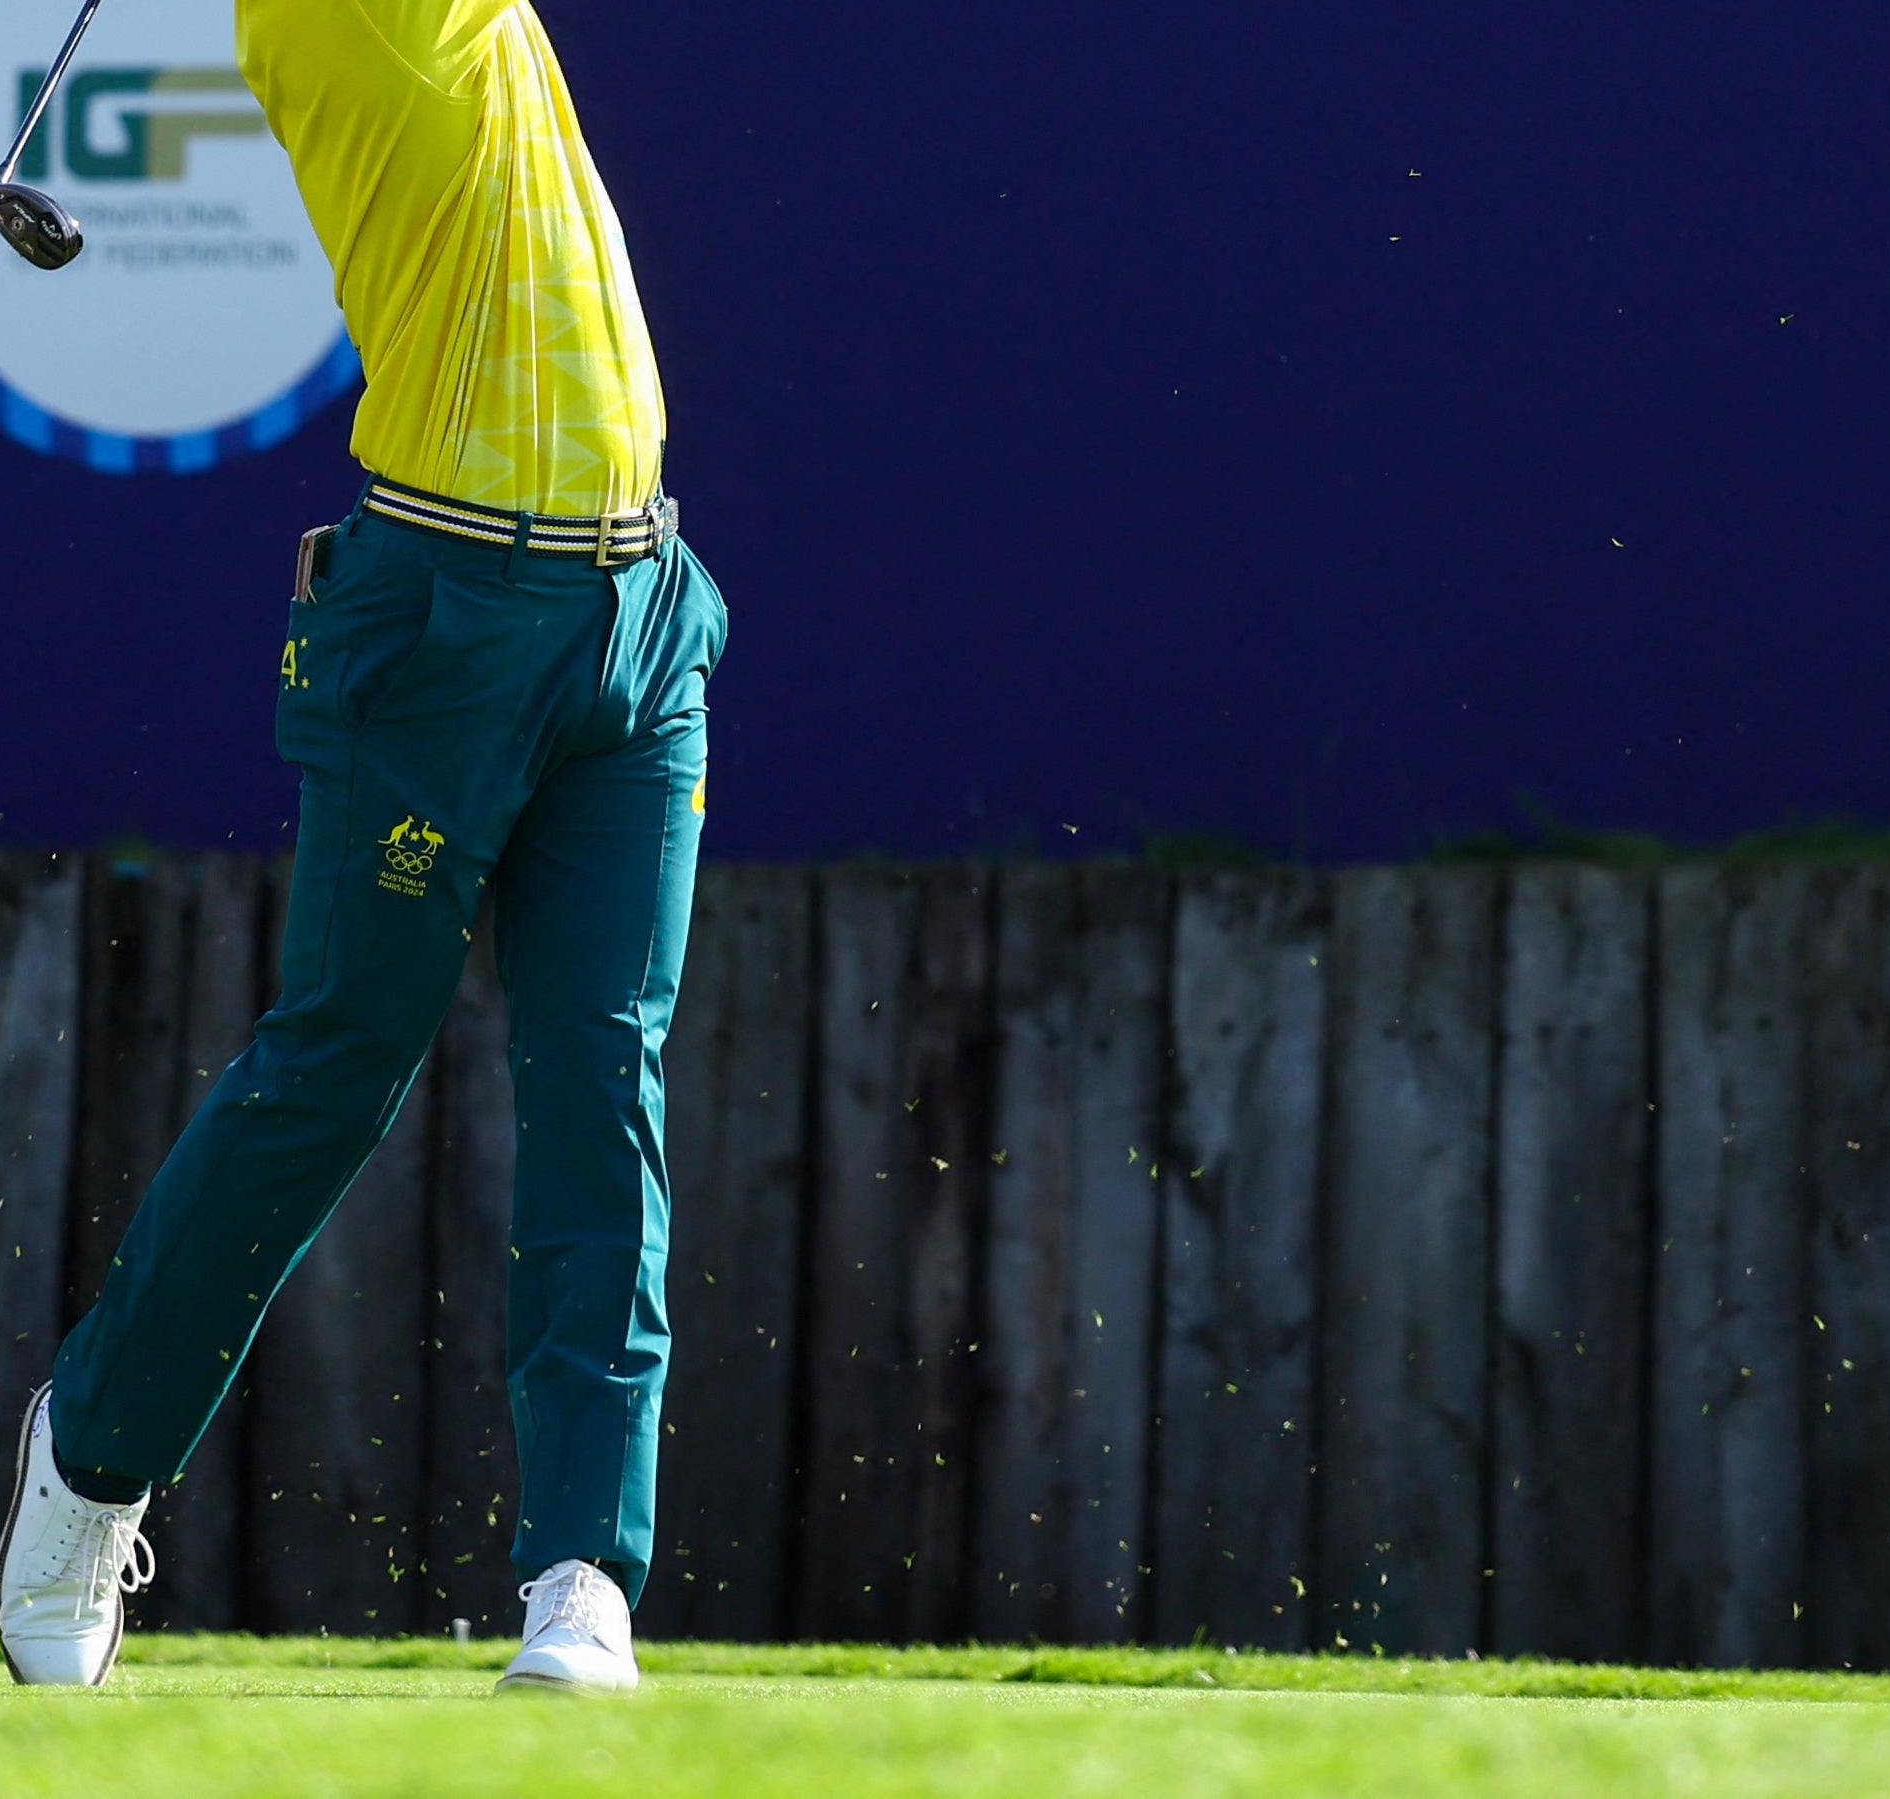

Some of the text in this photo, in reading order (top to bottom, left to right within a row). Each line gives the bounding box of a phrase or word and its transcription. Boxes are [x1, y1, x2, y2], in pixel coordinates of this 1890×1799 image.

[18, 67, 267, 179] IGF
[378, 879, 424, 896] PARIS 2024
[380, 871, 426, 888] AUSTRALIA
